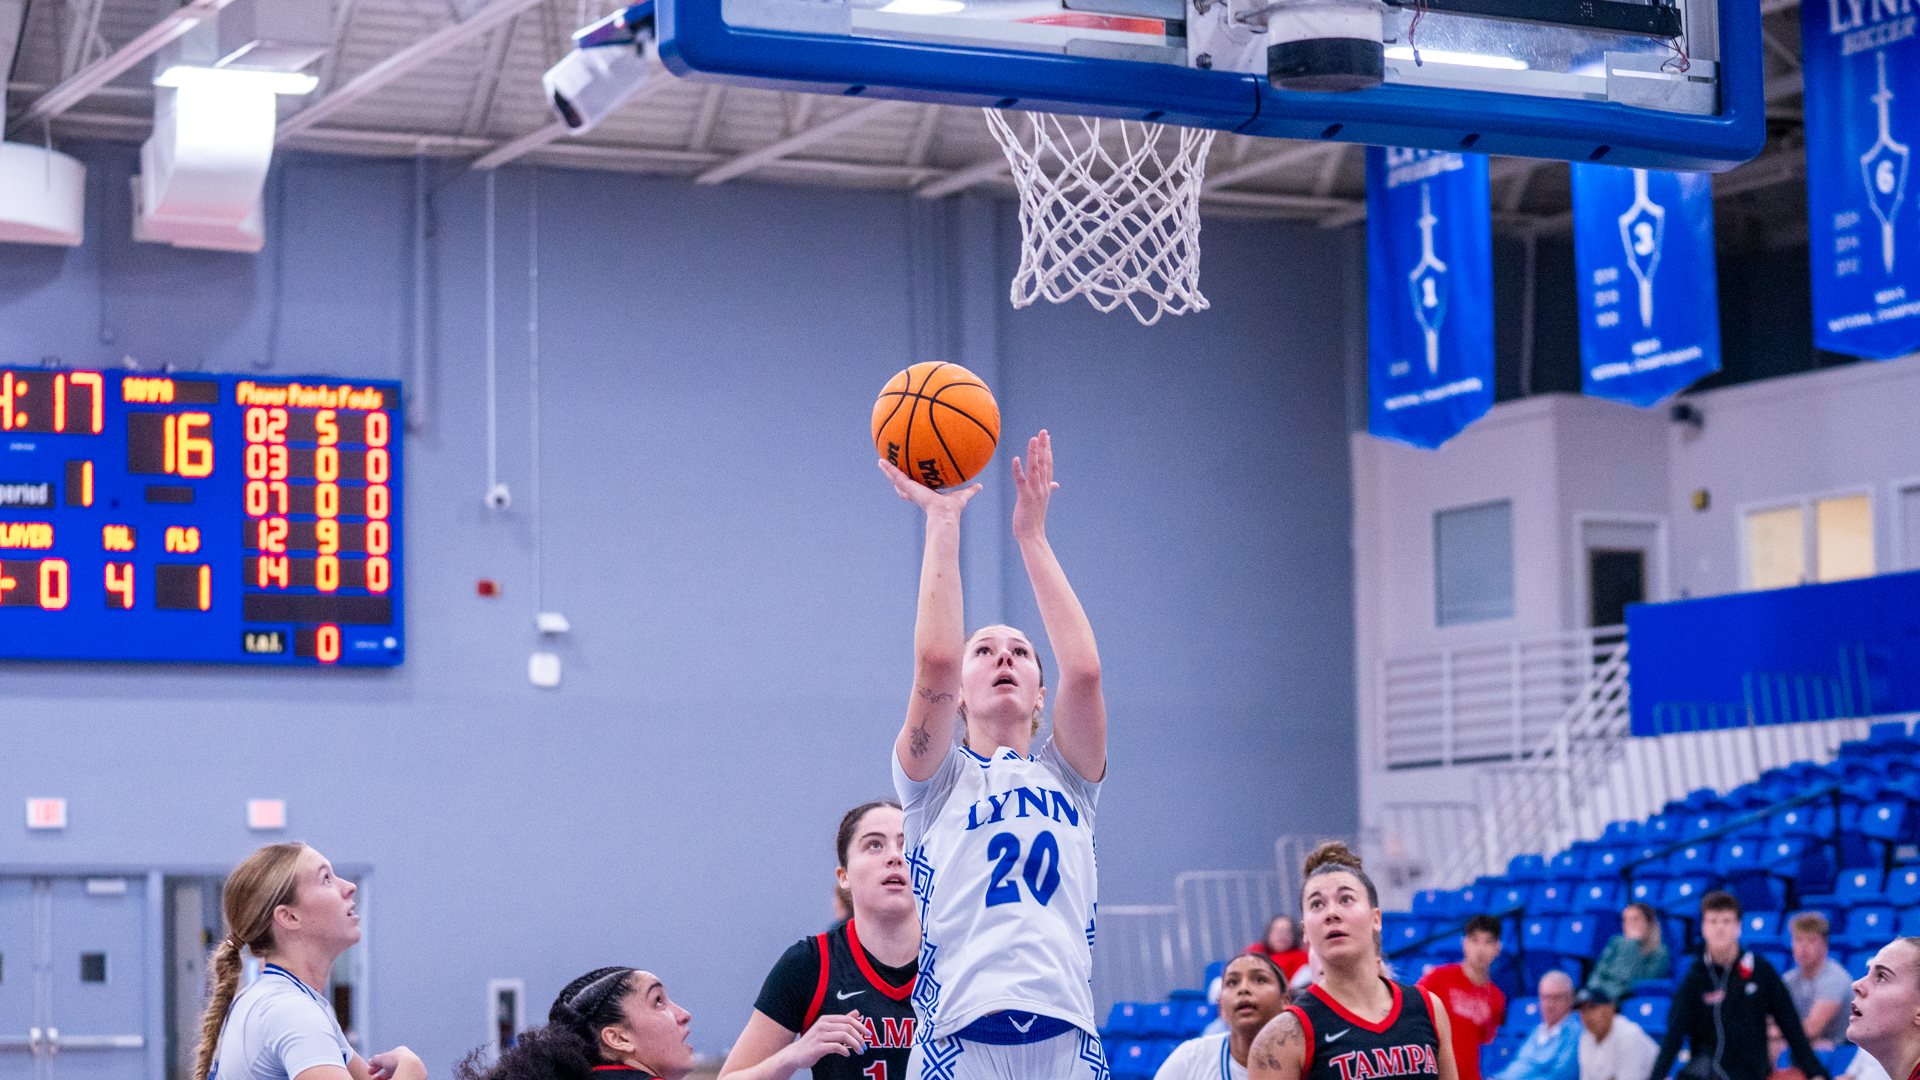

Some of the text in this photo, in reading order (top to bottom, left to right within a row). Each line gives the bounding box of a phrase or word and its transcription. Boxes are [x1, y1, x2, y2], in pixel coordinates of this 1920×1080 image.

[1876, 159, 1895, 194] 6
[1634, 222, 1655, 256] 3
[1422, 277, 1439, 308] 1
[163, 412, 214, 478] 16
[245, 407, 389, 447] 02 5 0
[82, 460, 93, 507] 1
[245, 443, 389, 484] 03 0 0
[245, 480, 390, 520] 07 0 0
[257, 516, 390, 555] 12 9 0
[104, 561, 135, 609] 4
[198, 564, 211, 611] 1
[257, 554, 390, 593] 14 0 0
[316, 623, 340, 663] 0
[965, 786, 1079, 831] LYNN
[985, 830, 1061, 908] 20
[1329, 1044, 1438, 1080] TAMPA
